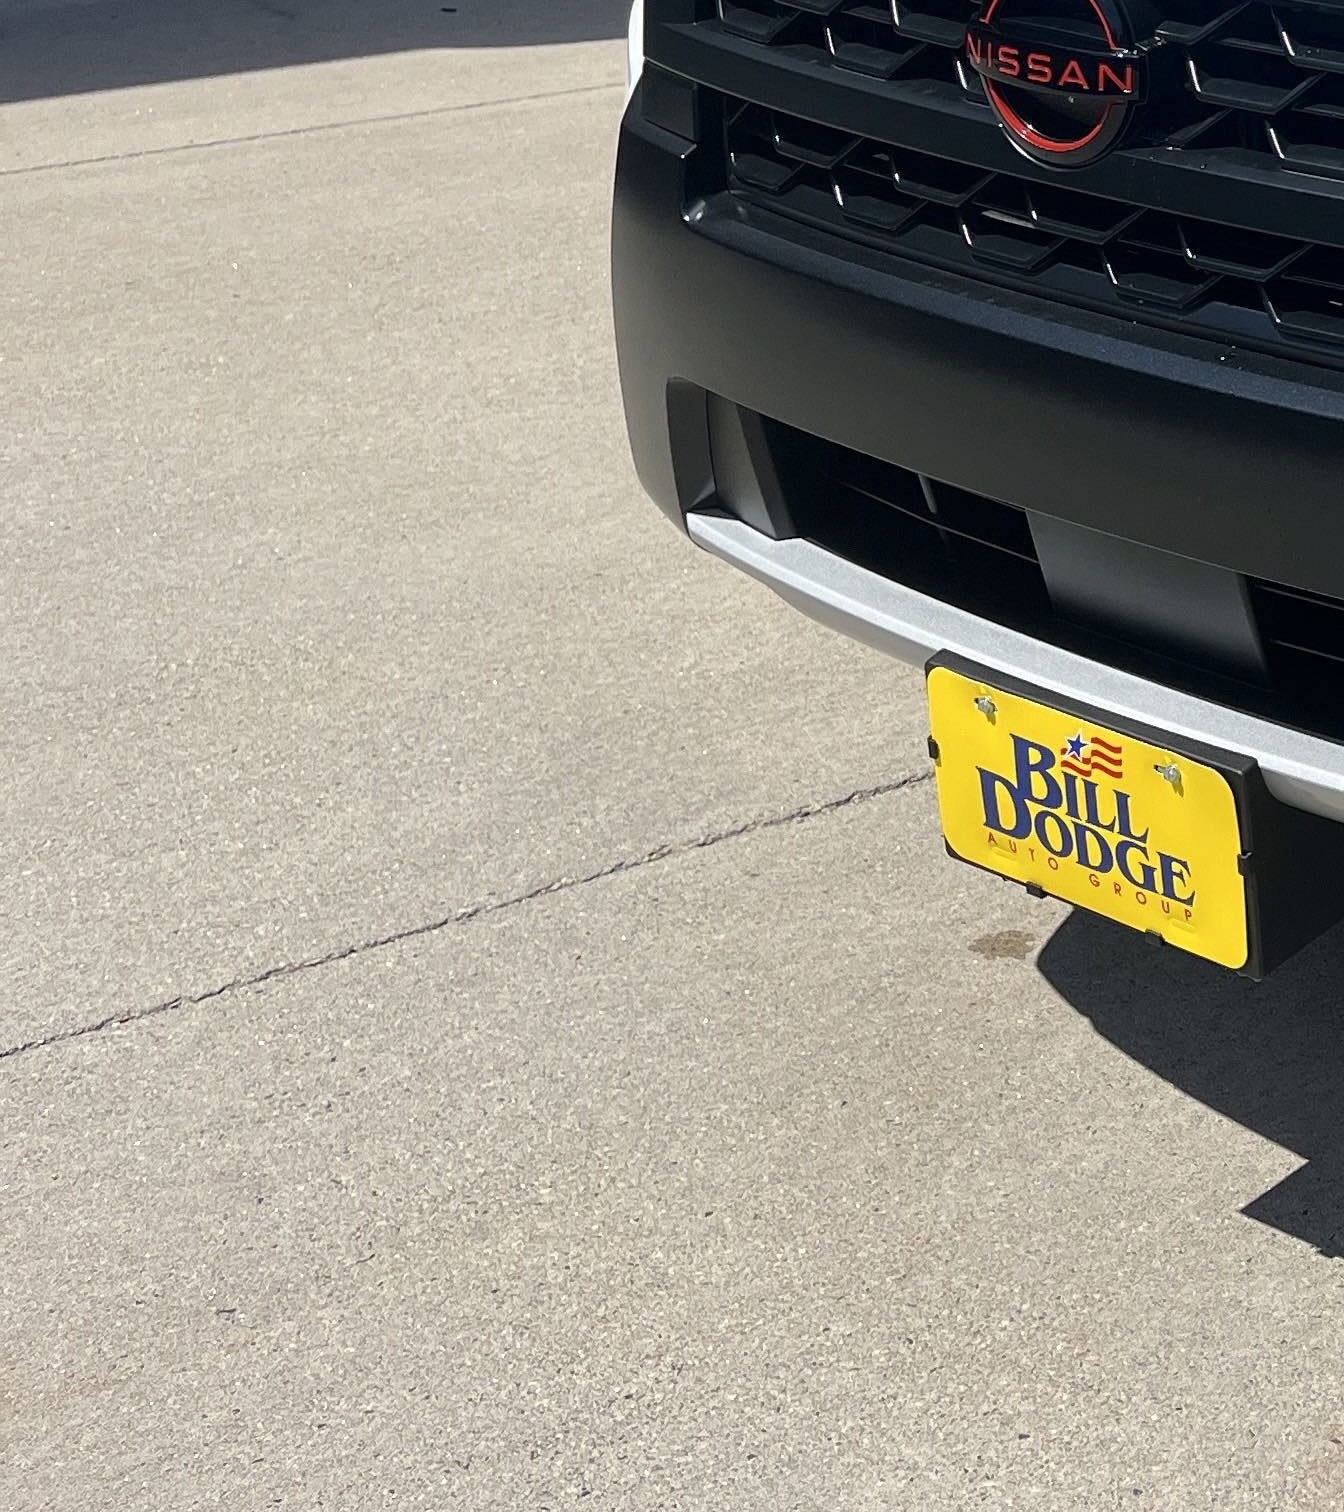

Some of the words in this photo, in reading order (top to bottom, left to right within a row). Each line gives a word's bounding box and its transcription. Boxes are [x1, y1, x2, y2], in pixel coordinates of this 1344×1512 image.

[966, 32, 1133, 94] NISSAN
[975, 766, 1196, 907] DODGE
[1009, 732, 1150, 844] BILL
[987, 832, 1060, 871] AUTO
[1088, 873, 1194, 922] GROUP
